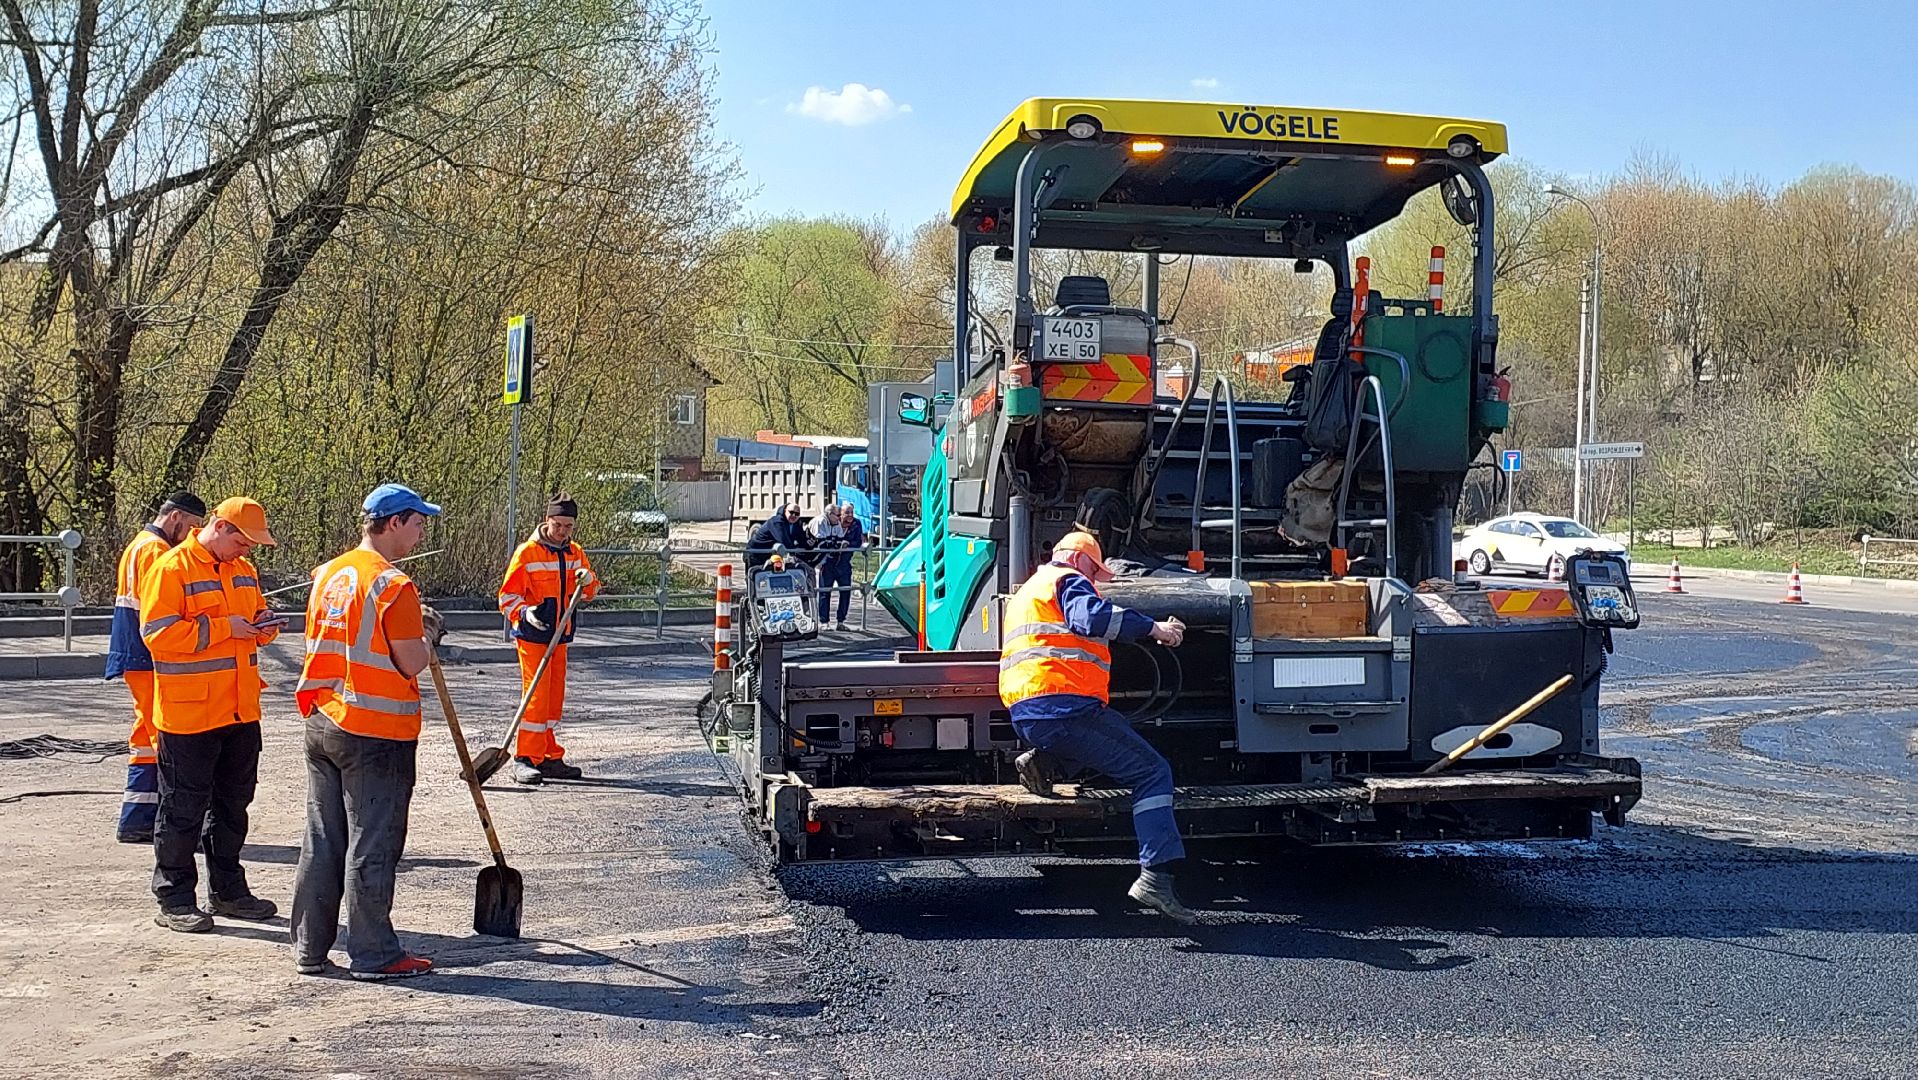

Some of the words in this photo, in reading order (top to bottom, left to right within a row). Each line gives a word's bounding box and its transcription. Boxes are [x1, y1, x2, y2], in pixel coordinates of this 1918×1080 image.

[1217, 105, 1340, 140] VÖGELE
[1051, 321, 1094, 339] 4403
[1079, 344, 1096, 358] 50
